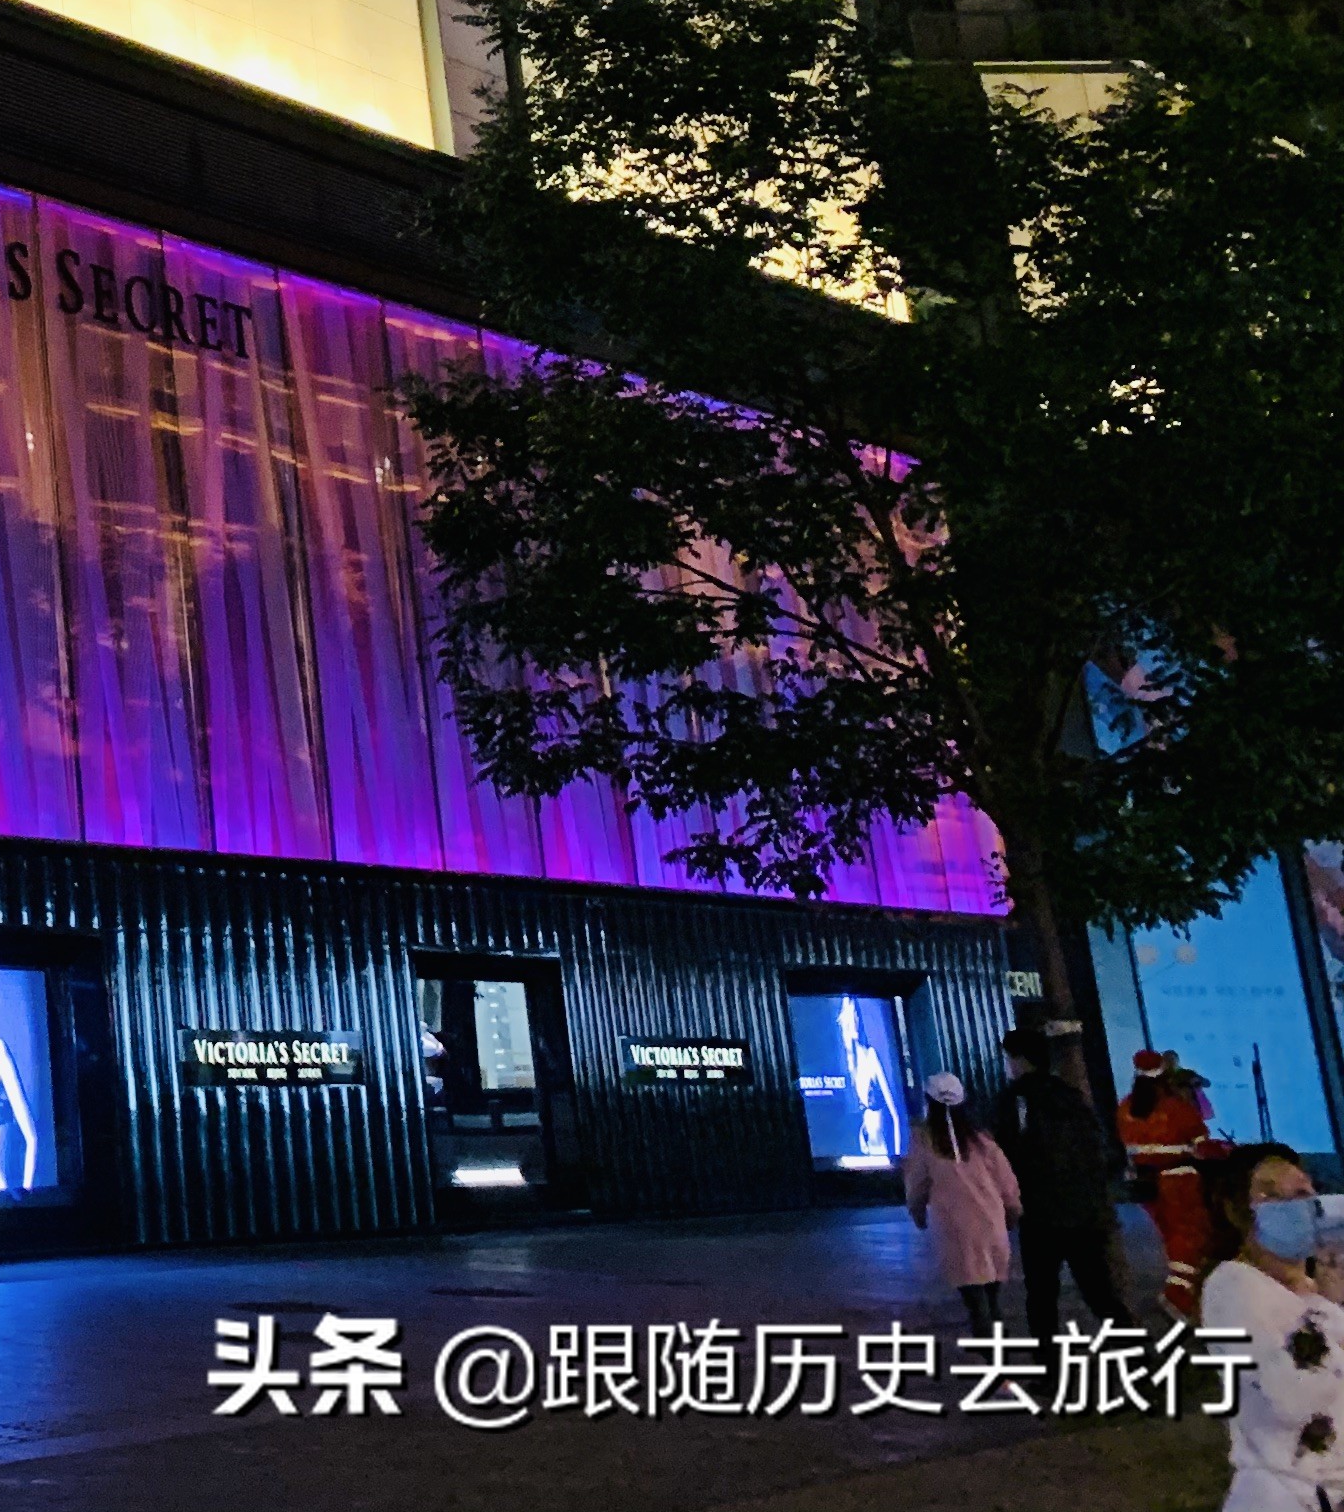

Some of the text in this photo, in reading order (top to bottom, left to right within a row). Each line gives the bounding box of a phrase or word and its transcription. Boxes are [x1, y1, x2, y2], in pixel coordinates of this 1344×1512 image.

[56, 248, 253, 359] SECRET
[193, 1039, 349, 1065] VICTORIA'S SECRET
[630, 1044, 743, 1066] VICTORIA'S SECRET
